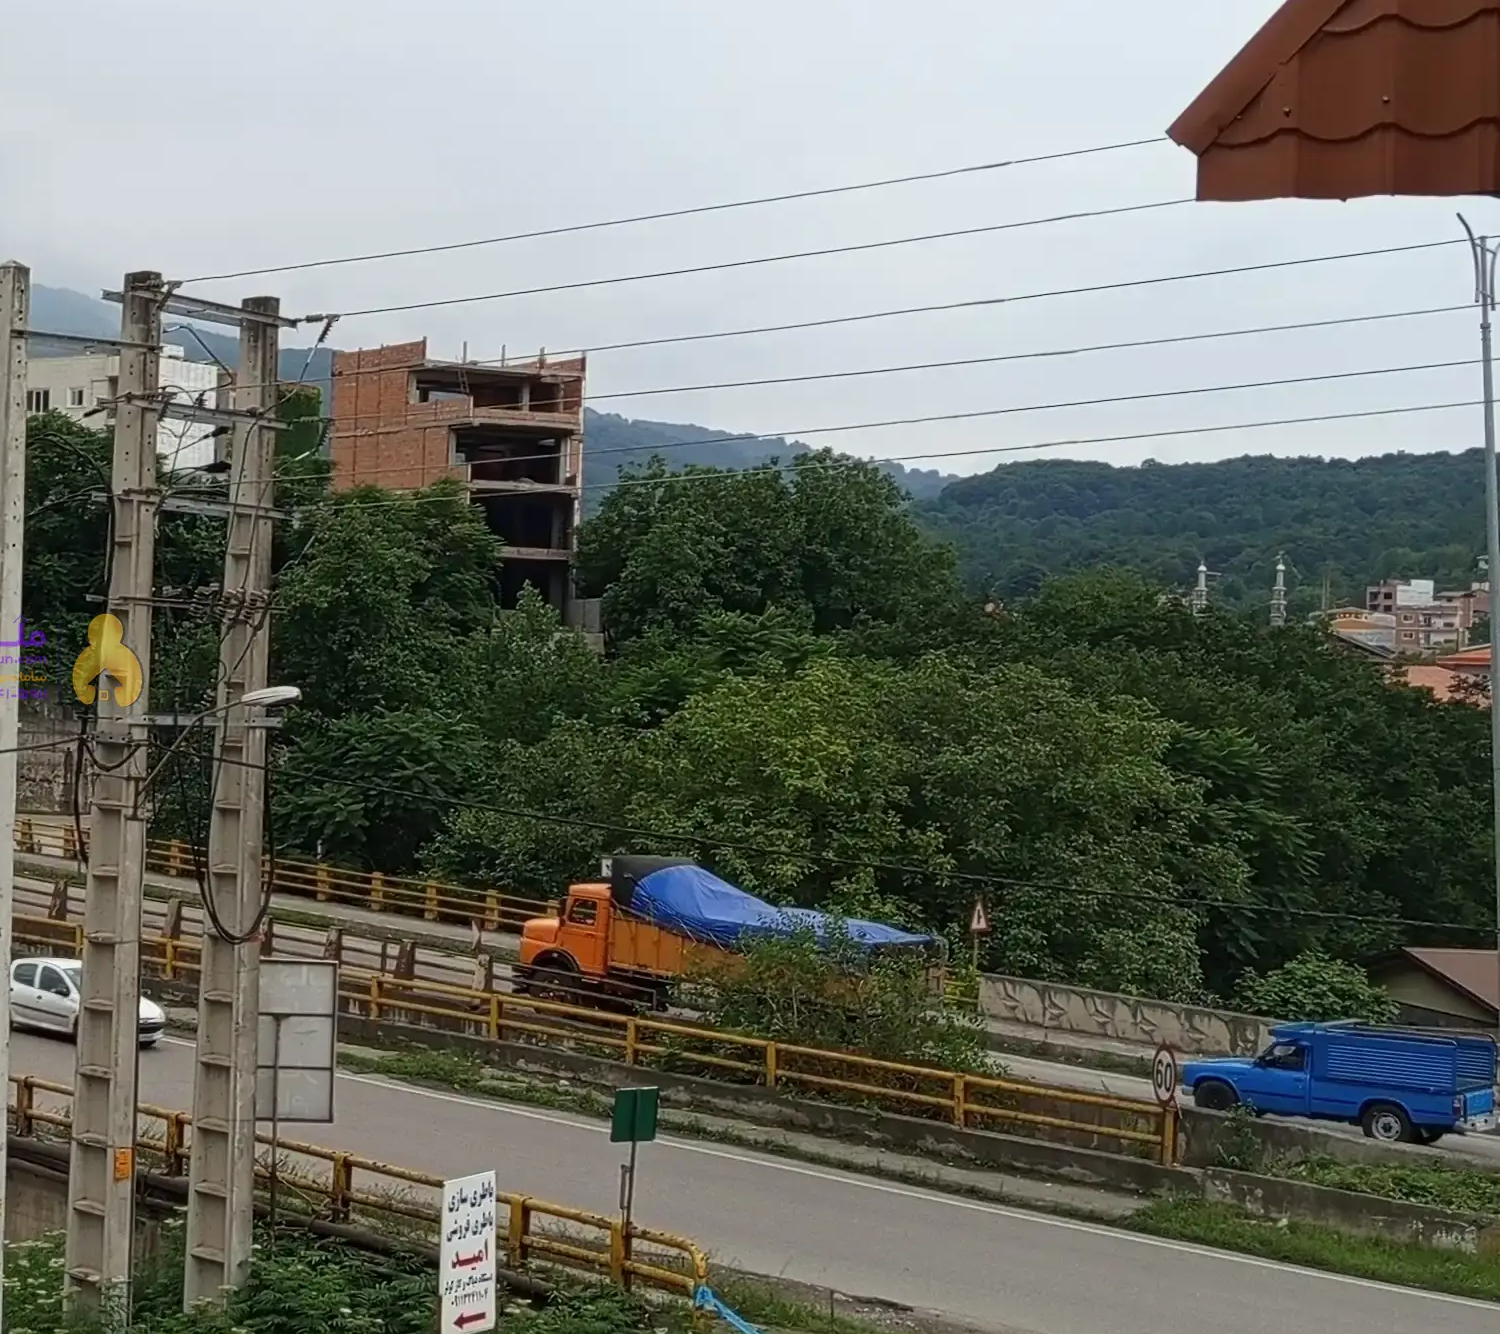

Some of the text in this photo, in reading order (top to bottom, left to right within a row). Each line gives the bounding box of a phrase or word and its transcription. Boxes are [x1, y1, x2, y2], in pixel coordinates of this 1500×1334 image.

[1156, 1058, 1172, 1092] 60
[448, 1180, 493, 1213] باطری سازی
[446, 1211, 493, 1242] باطری فروشی
[451, 1238, 489, 1270] امید
